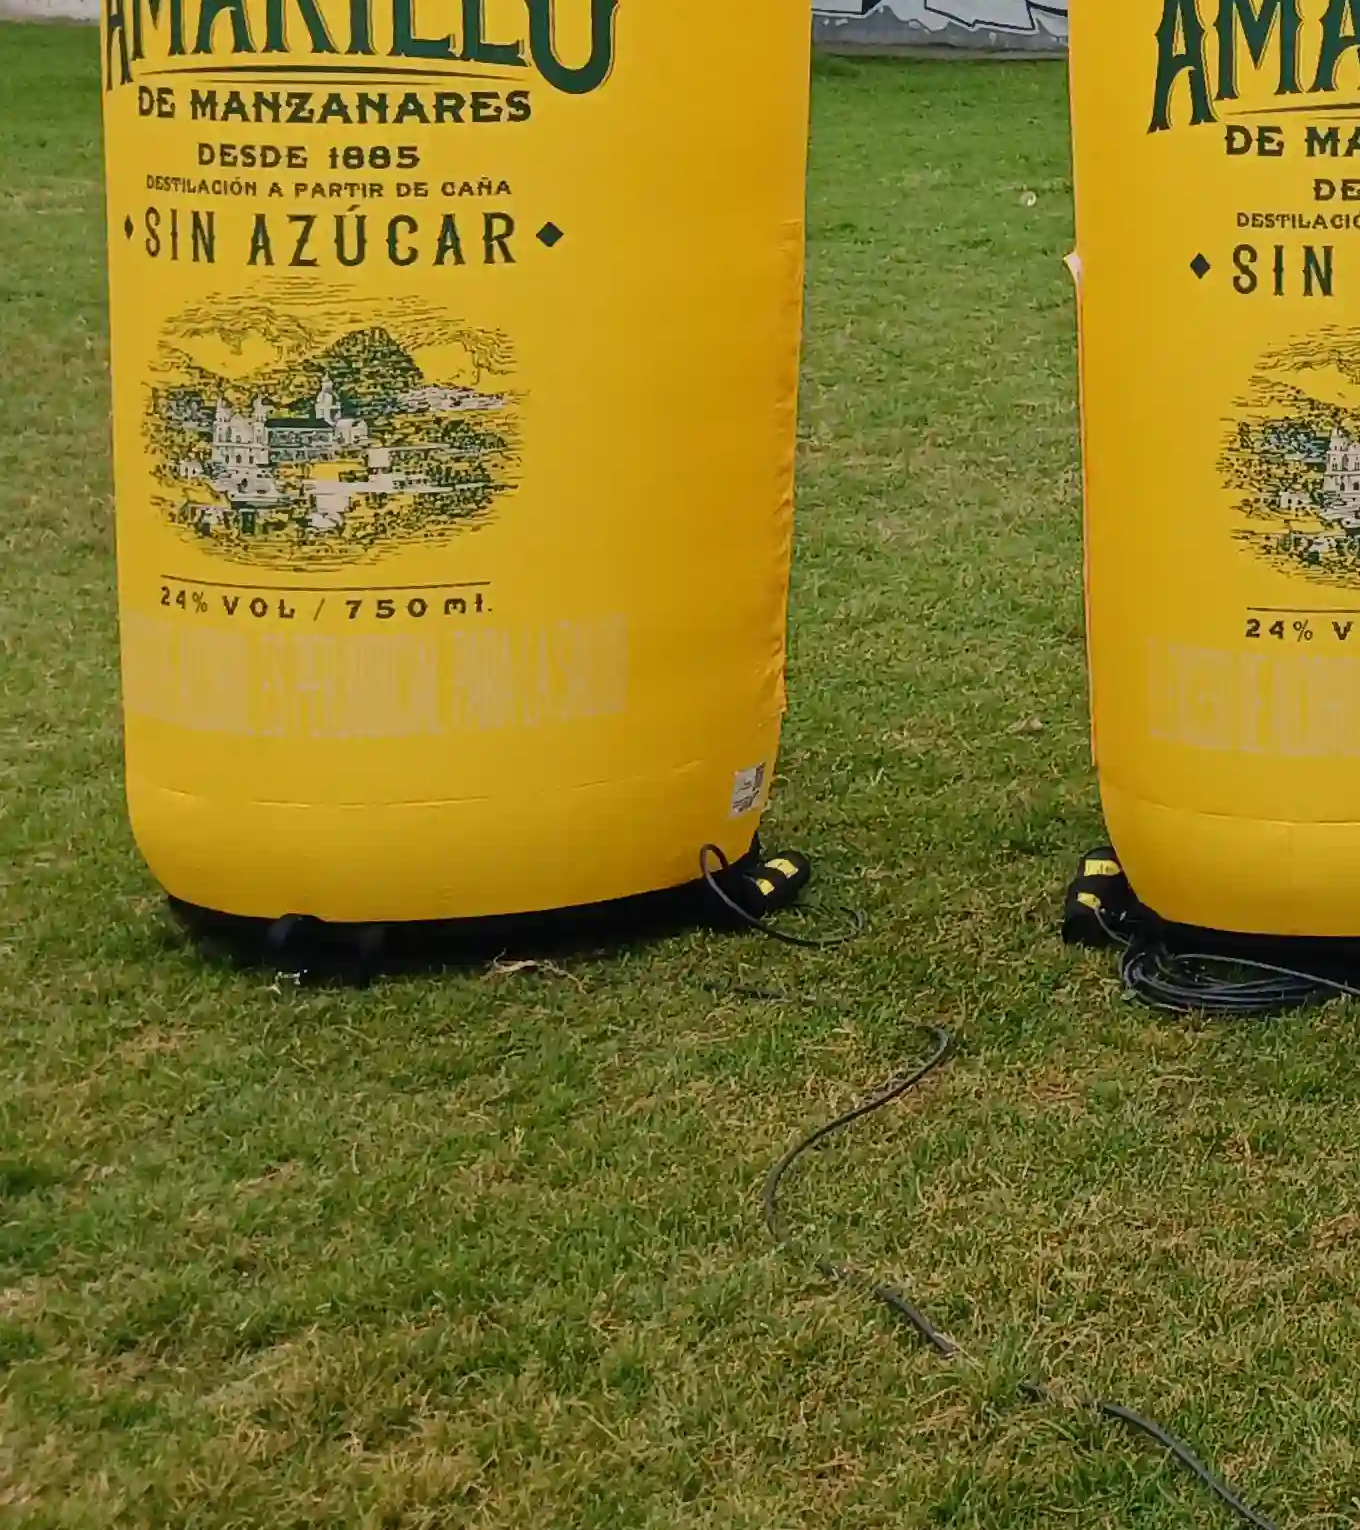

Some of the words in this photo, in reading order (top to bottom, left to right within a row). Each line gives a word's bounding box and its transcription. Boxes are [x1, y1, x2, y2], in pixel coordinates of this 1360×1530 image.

[138, 85, 176, 120] DE
[190, 88, 533, 126] MANZANARES
[196, 141, 309, 170] DESDE
[328, 145, 421, 170] 1885
[1223, 123, 1285, 158] DE
[145, 173, 258, 199] DESTILACIÓN
[267, 180, 284, 199] A
[294, 179, 385, 199] PARTIR
[395, 181, 430, 199] DE
[440, 174, 513, 198] CAÑA
[144, 205, 217, 265] SIN
[246, 203, 517, 268] AZÚCAR
[1231, 242, 1335, 298] SIN
[159, 585, 209, 615] 24%
[221, 594, 296, 620] VOL
[1244, 617, 1314, 642] 24%
